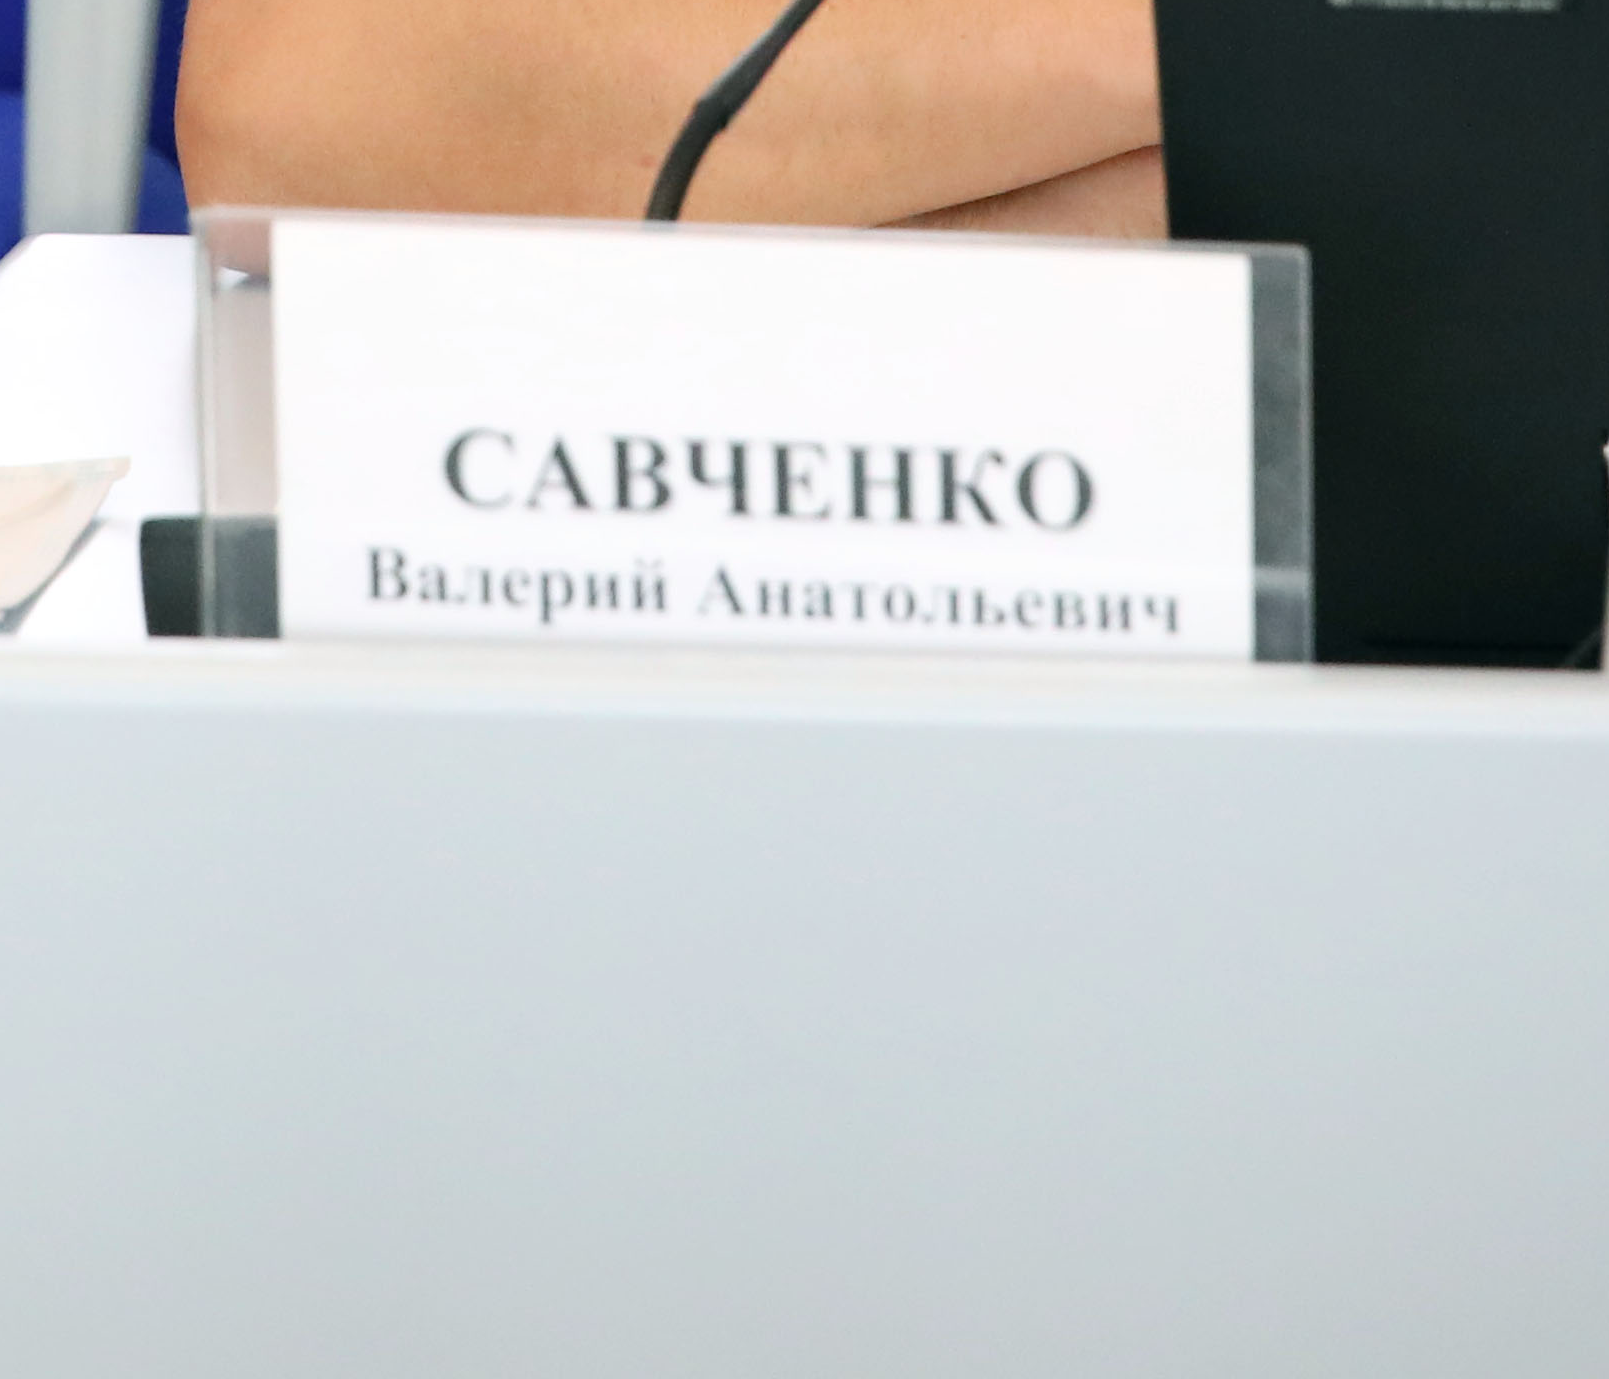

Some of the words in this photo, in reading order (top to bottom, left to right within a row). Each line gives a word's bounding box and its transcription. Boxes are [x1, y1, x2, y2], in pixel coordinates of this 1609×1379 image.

[441, 428, 1097, 533] САВЧЕНКО
[366, 545, 669, 627] Валерий
[697, 563, 1183, 637] Анатольевич
